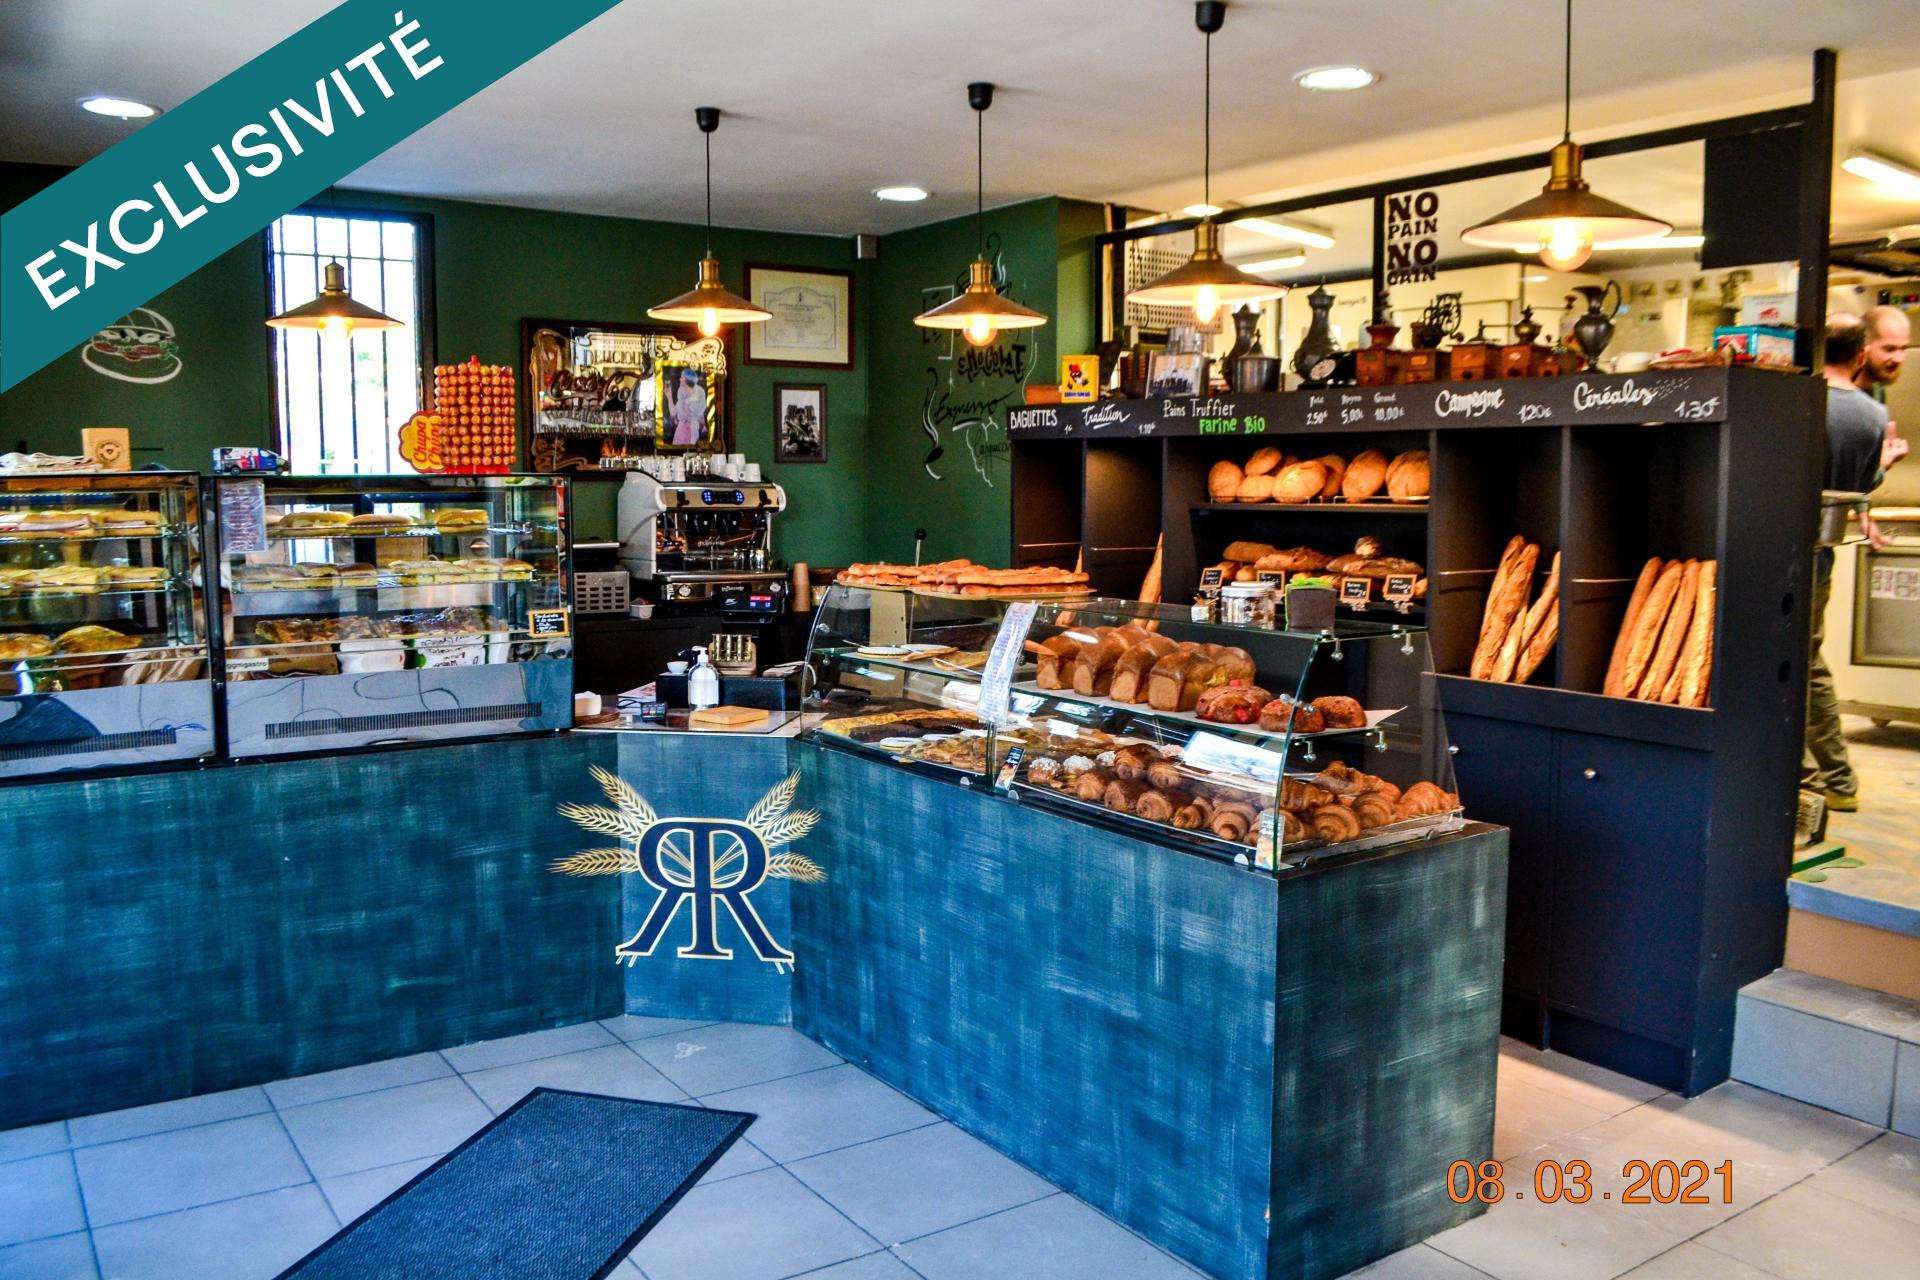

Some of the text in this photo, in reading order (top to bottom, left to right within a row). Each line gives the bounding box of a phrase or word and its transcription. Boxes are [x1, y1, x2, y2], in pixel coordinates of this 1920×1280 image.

[1388, 191, 1439, 224] NO
[1388, 218, 1438, 240] PAIN
[1387, 239, 1438, 270] NO
[1010, 408, 1059, 430] BAGUETTES
[1163, 398, 1236, 418] Pains Truffier
